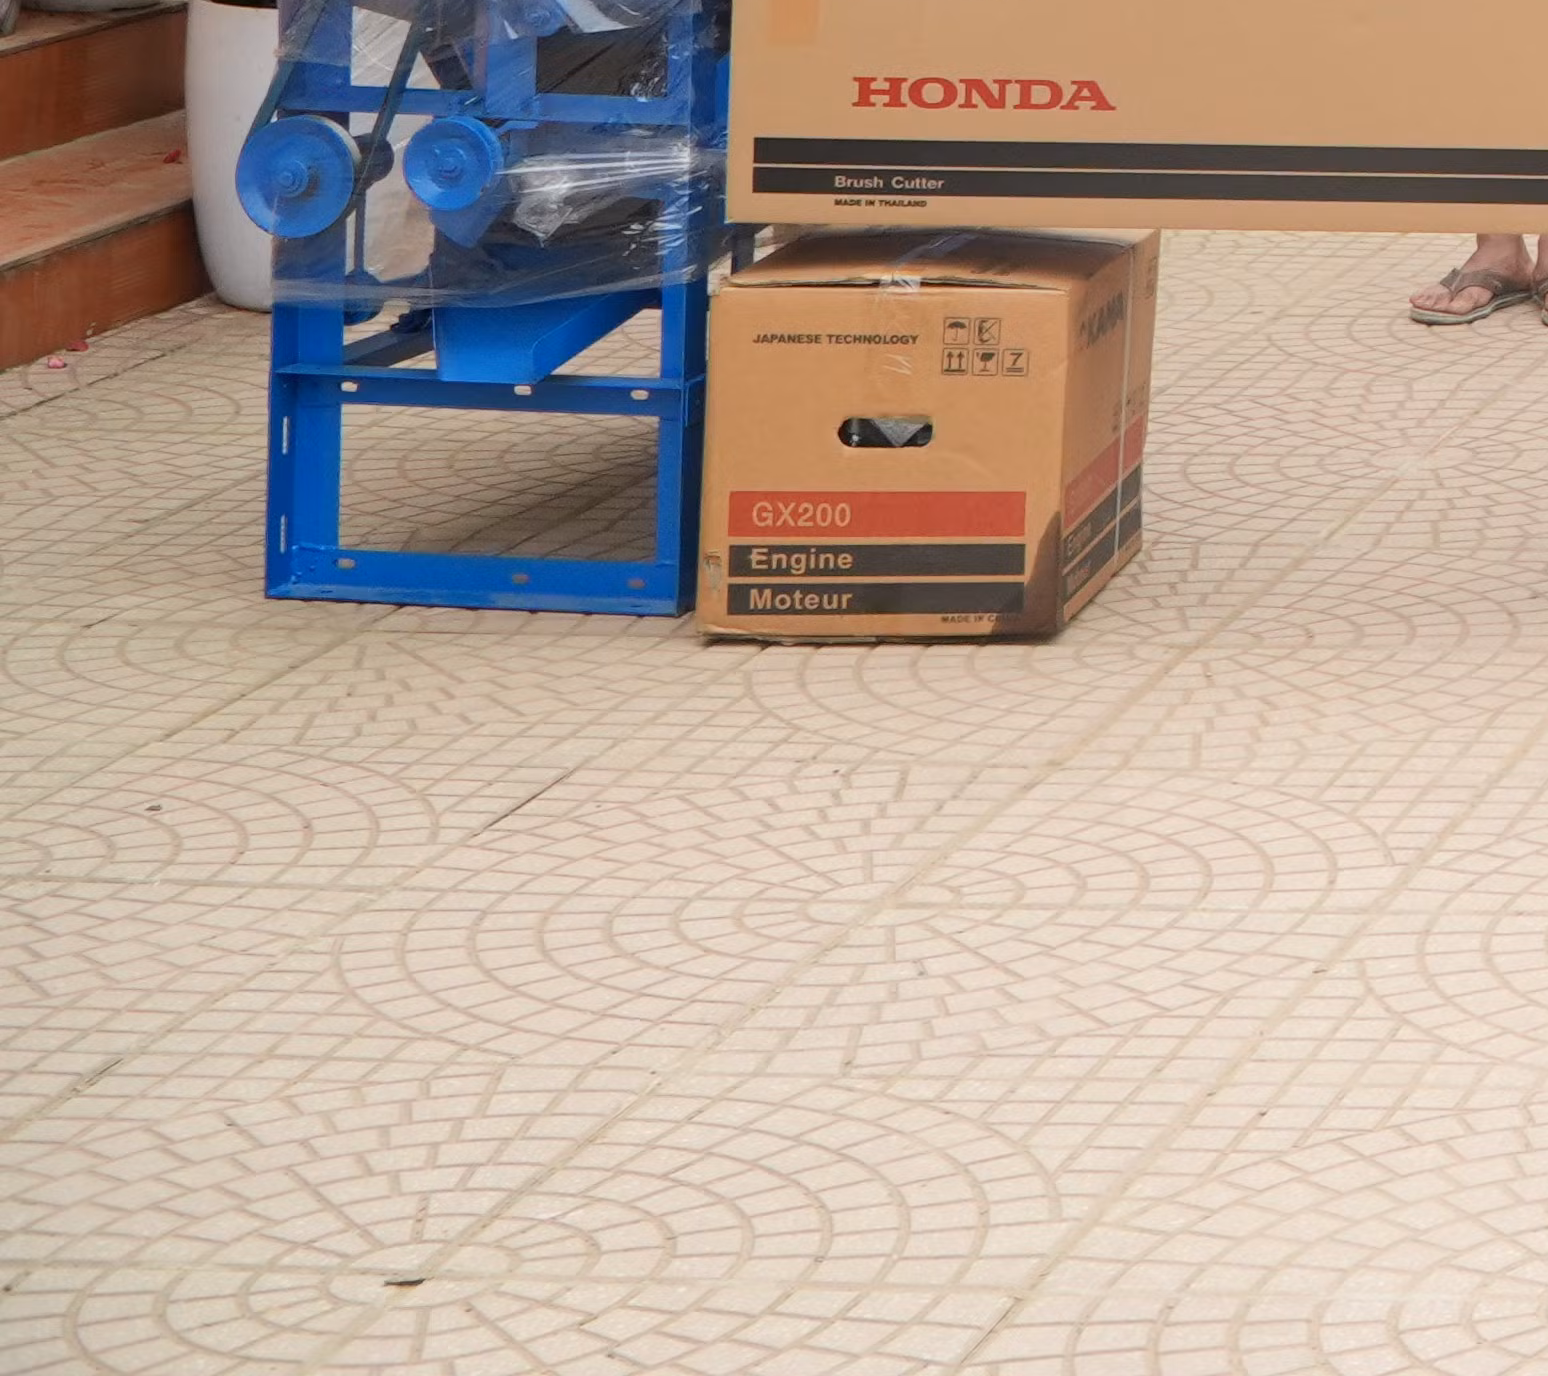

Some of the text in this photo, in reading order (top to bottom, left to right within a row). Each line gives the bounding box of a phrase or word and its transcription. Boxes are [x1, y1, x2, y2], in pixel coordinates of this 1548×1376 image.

[851, 76, 1117, 111] HONDA
[834, 175, 945, 189] Brush Cutter
[834, 199, 928, 208] MADE IN THAILAND
[752, 333, 920, 346] JAPANESE TECHNOLOGY
[752, 502, 852, 527] GX200
[751, 548, 853, 575] Engine
[749, 588, 853, 610] Moteur
[941, 615, 971, 624] MADE
